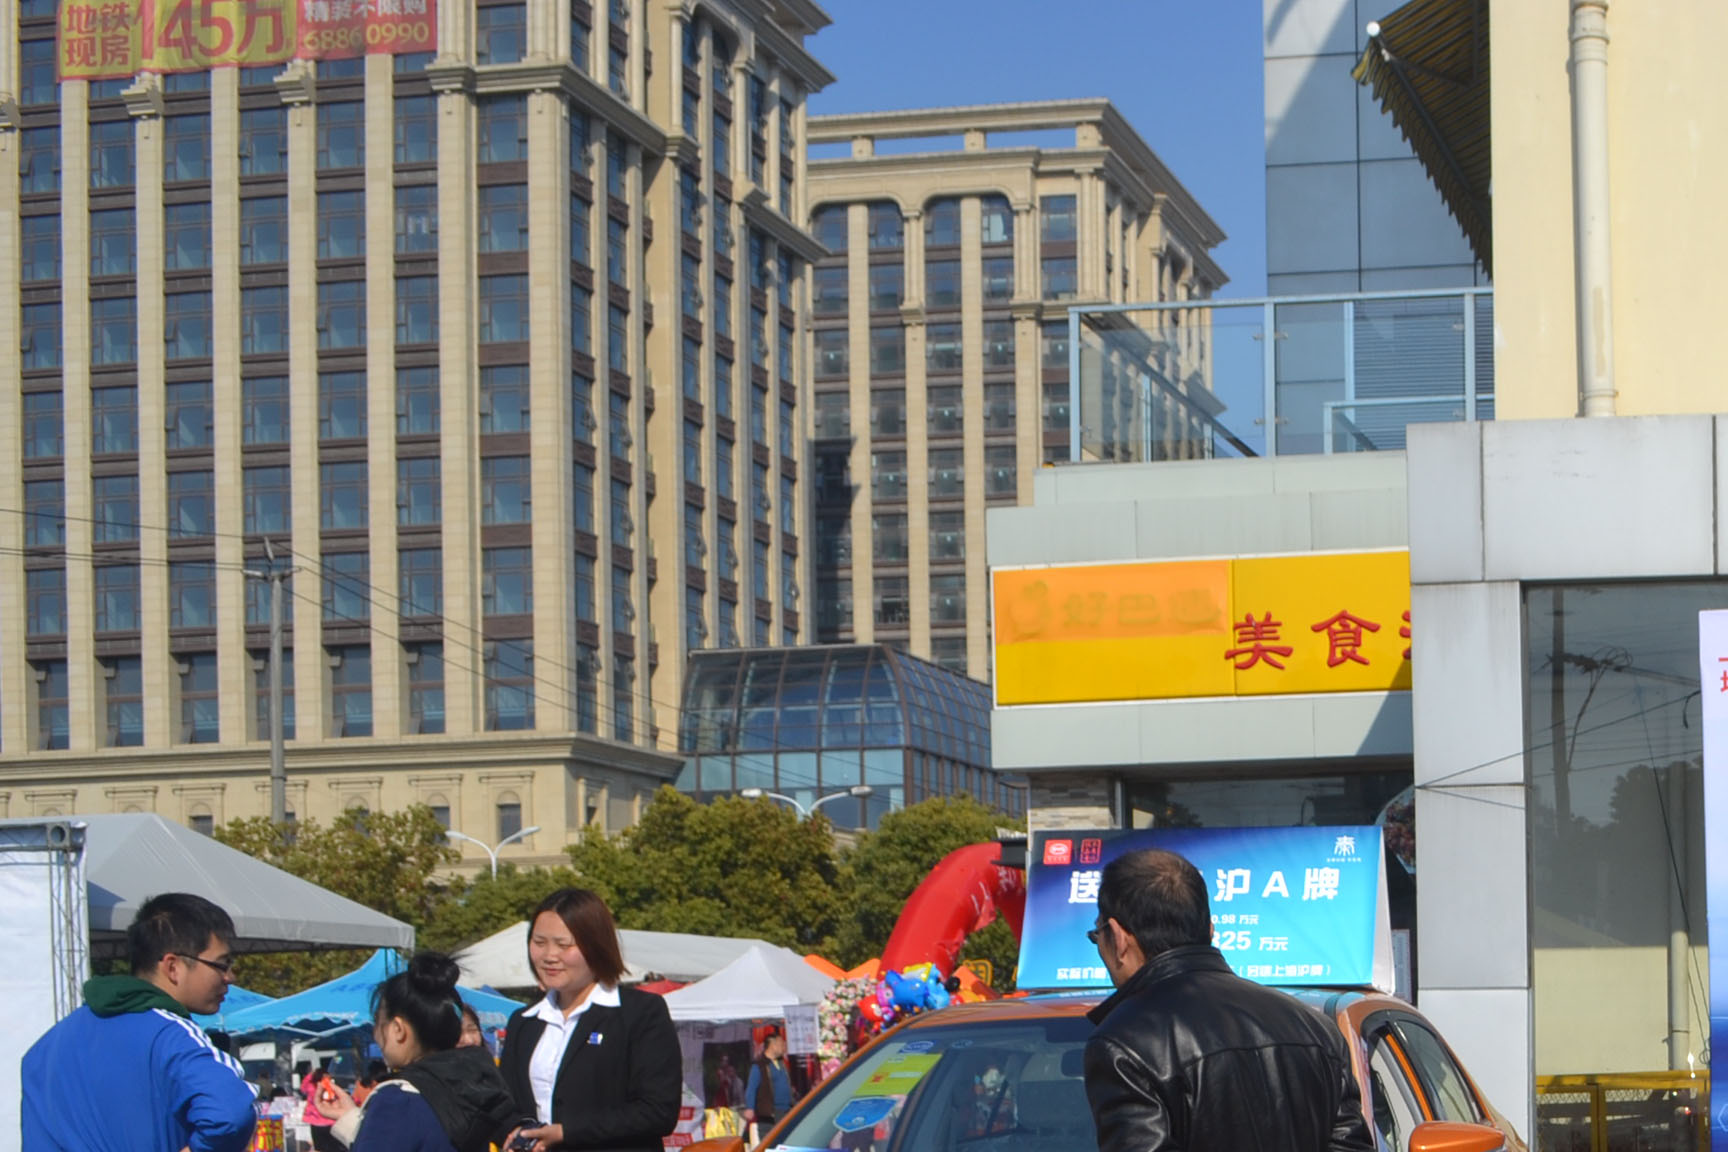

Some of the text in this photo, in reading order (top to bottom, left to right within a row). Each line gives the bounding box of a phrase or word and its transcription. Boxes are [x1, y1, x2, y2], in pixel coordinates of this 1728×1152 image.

[65, 2, 131, 35] 地铁
[65, 36, 131, 68] 现房
[304, 21, 430, 51] 68860990
[1224, 609, 1411, 671] 美食
[1258, 936, 1289, 951] 万元
